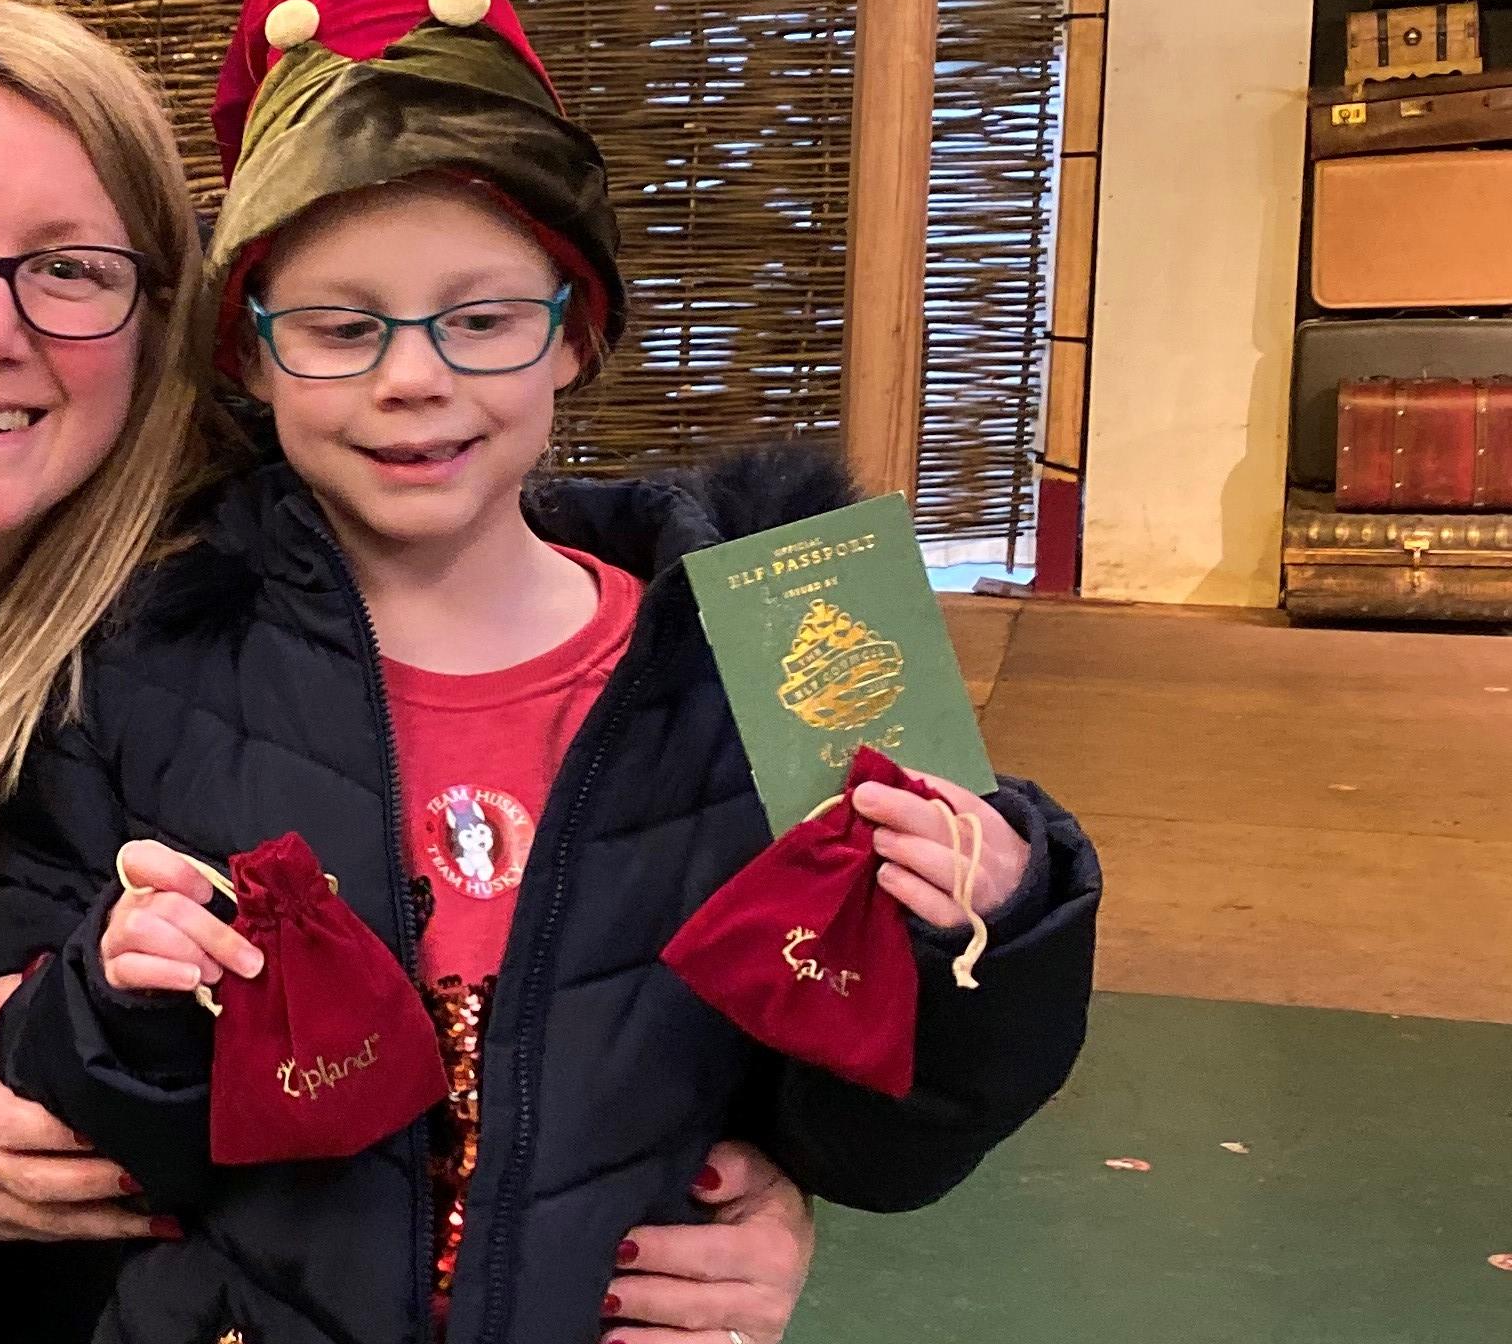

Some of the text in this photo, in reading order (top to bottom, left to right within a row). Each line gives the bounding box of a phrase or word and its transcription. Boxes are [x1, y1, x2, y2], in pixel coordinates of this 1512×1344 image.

[728, 533, 875, 590] ELF PASSPORT
[426, 787, 528, 826] TEAM HUSKY
[426, 843, 524, 895] TEAM HUSKY
